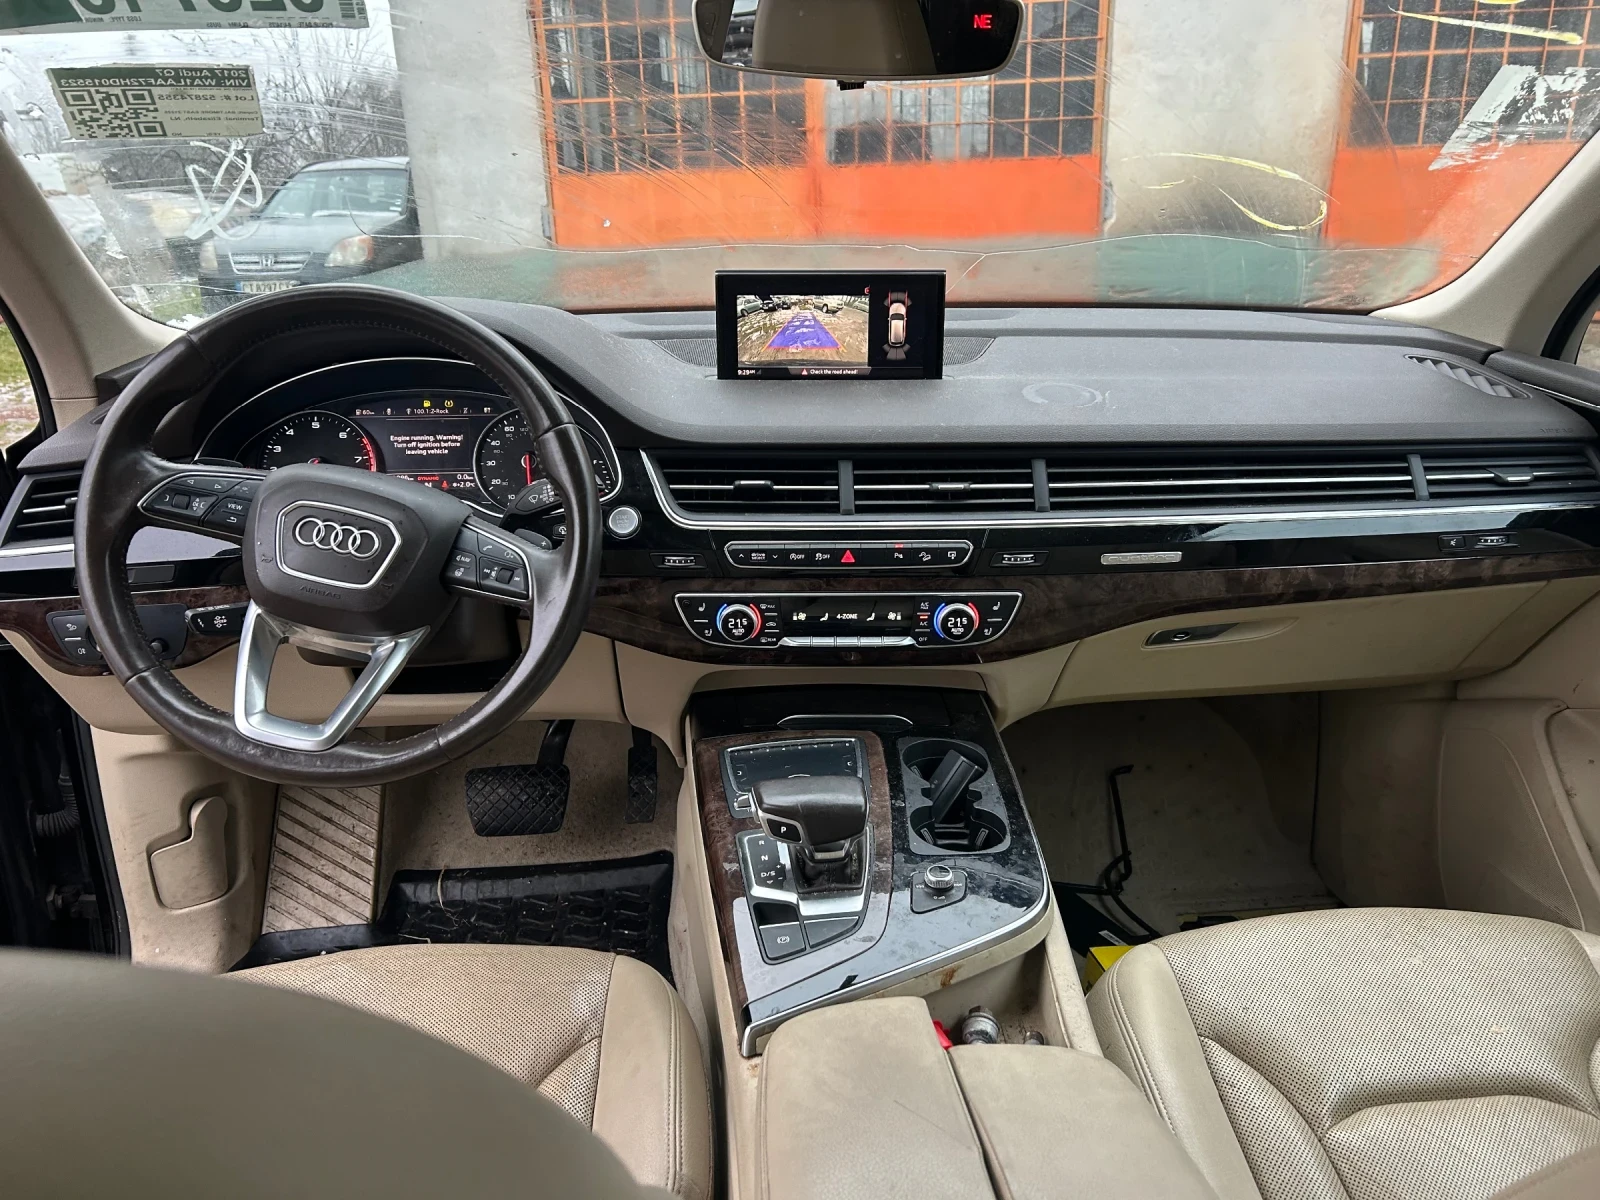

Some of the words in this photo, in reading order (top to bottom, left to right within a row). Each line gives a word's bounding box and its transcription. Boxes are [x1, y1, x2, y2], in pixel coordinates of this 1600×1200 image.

[973, 14, 993, 28] NE
[227, 502, 243, 510] VIEW
[300, 586, 341, 599] AIRBAG
